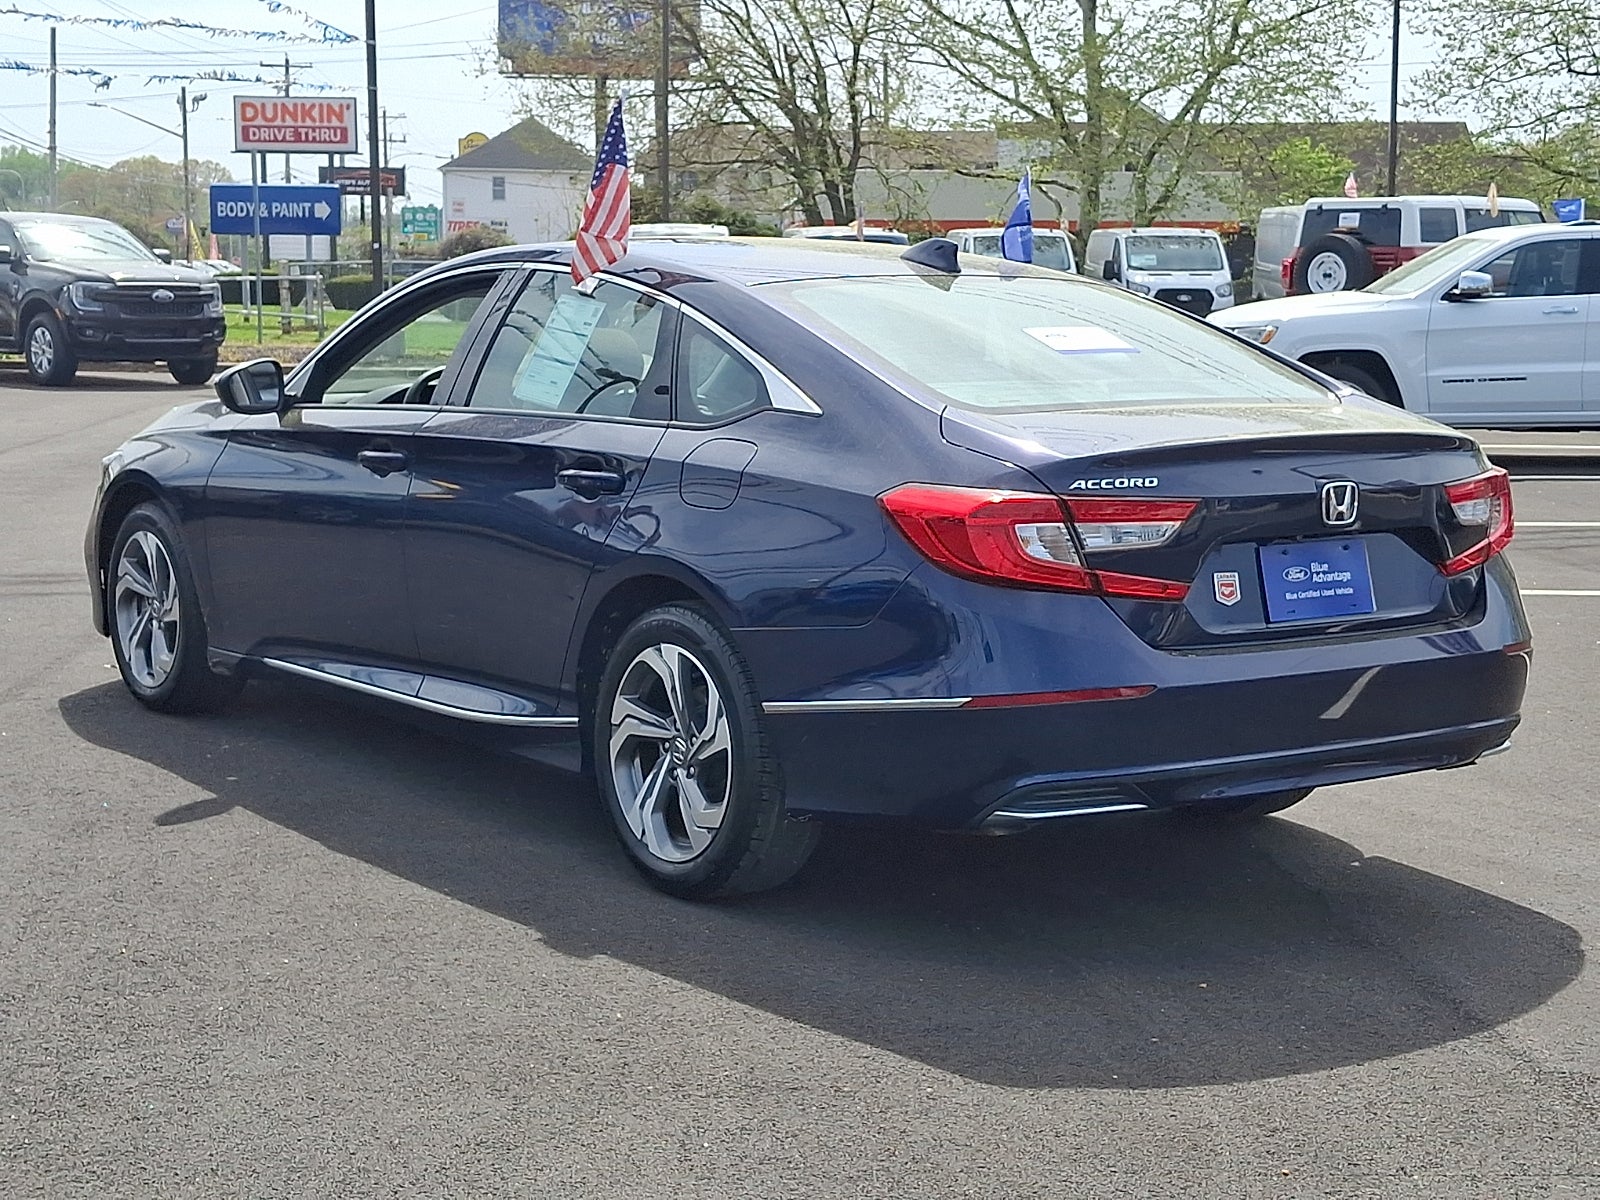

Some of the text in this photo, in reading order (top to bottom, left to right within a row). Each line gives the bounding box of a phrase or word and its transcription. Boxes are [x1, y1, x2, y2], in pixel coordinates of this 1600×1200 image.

[240, 102, 351, 123] DUNKIN'
[249, 127, 341, 142] DRIVE THRU
[217, 201, 311, 218] BODY & PAINT
[1068, 477, 1159, 490] ACCORD
[1310, 562, 1329, 573] Blue
[1312, 571, 1351, 583] Advantage
[1285, 592, 1298, 600] Blue
